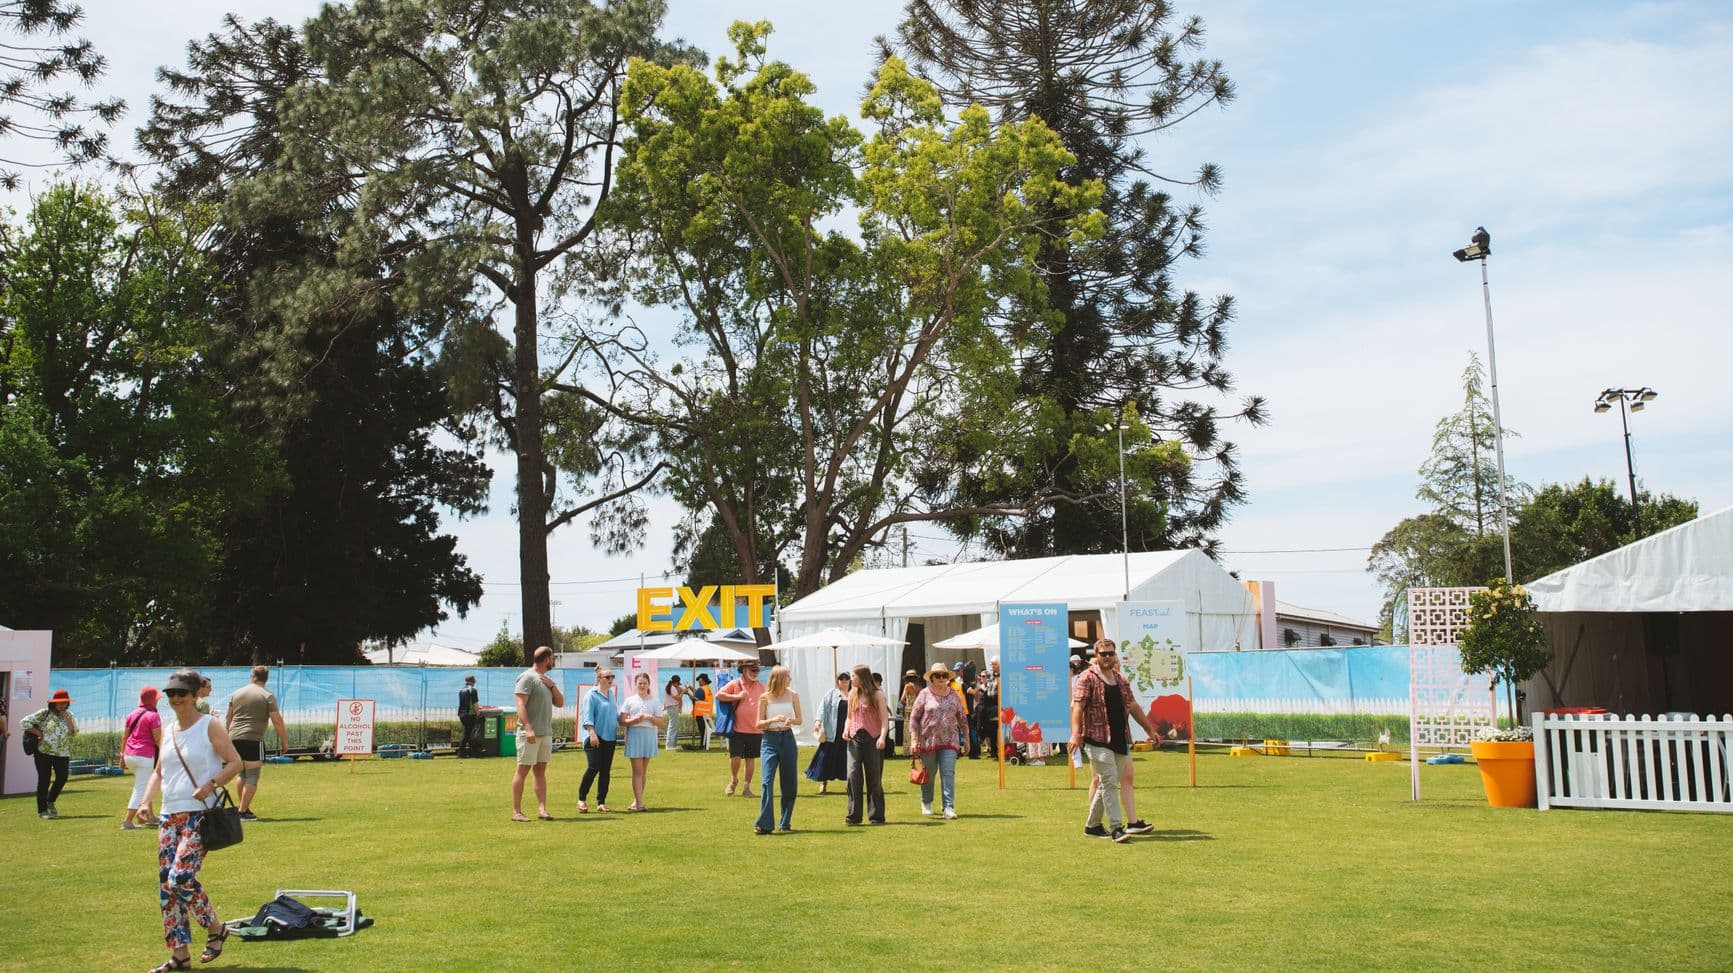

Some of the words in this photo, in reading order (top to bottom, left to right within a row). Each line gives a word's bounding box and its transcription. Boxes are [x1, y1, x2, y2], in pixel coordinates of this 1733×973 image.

[637, 583, 776, 631] EXIT
[1008, 608, 1042, 616] WHAT'S
[1044, 608, 1057, 616] ON
